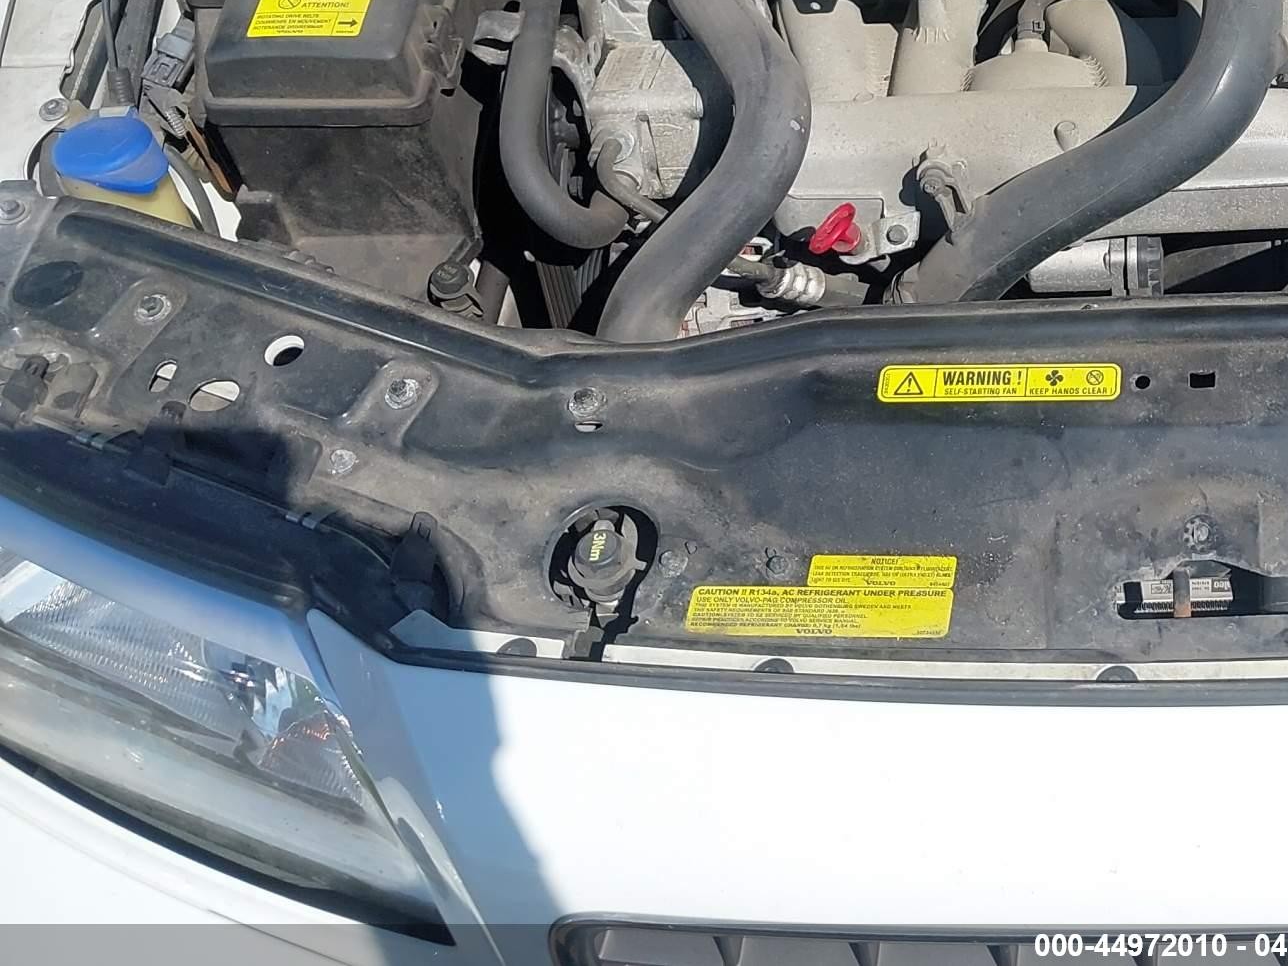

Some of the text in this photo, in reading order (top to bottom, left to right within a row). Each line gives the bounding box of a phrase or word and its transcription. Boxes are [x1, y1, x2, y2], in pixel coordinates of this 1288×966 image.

[942, 371, 1011, 385] WARNING
[1002, 387, 1017, 395] FAN
[589, 533, 607, 561] 3Nm
[864, 589, 896, 597] UNDER
[898, 589, 946, 597] PRESSURE
[780, 596, 834, 604] COMPRESSOR
